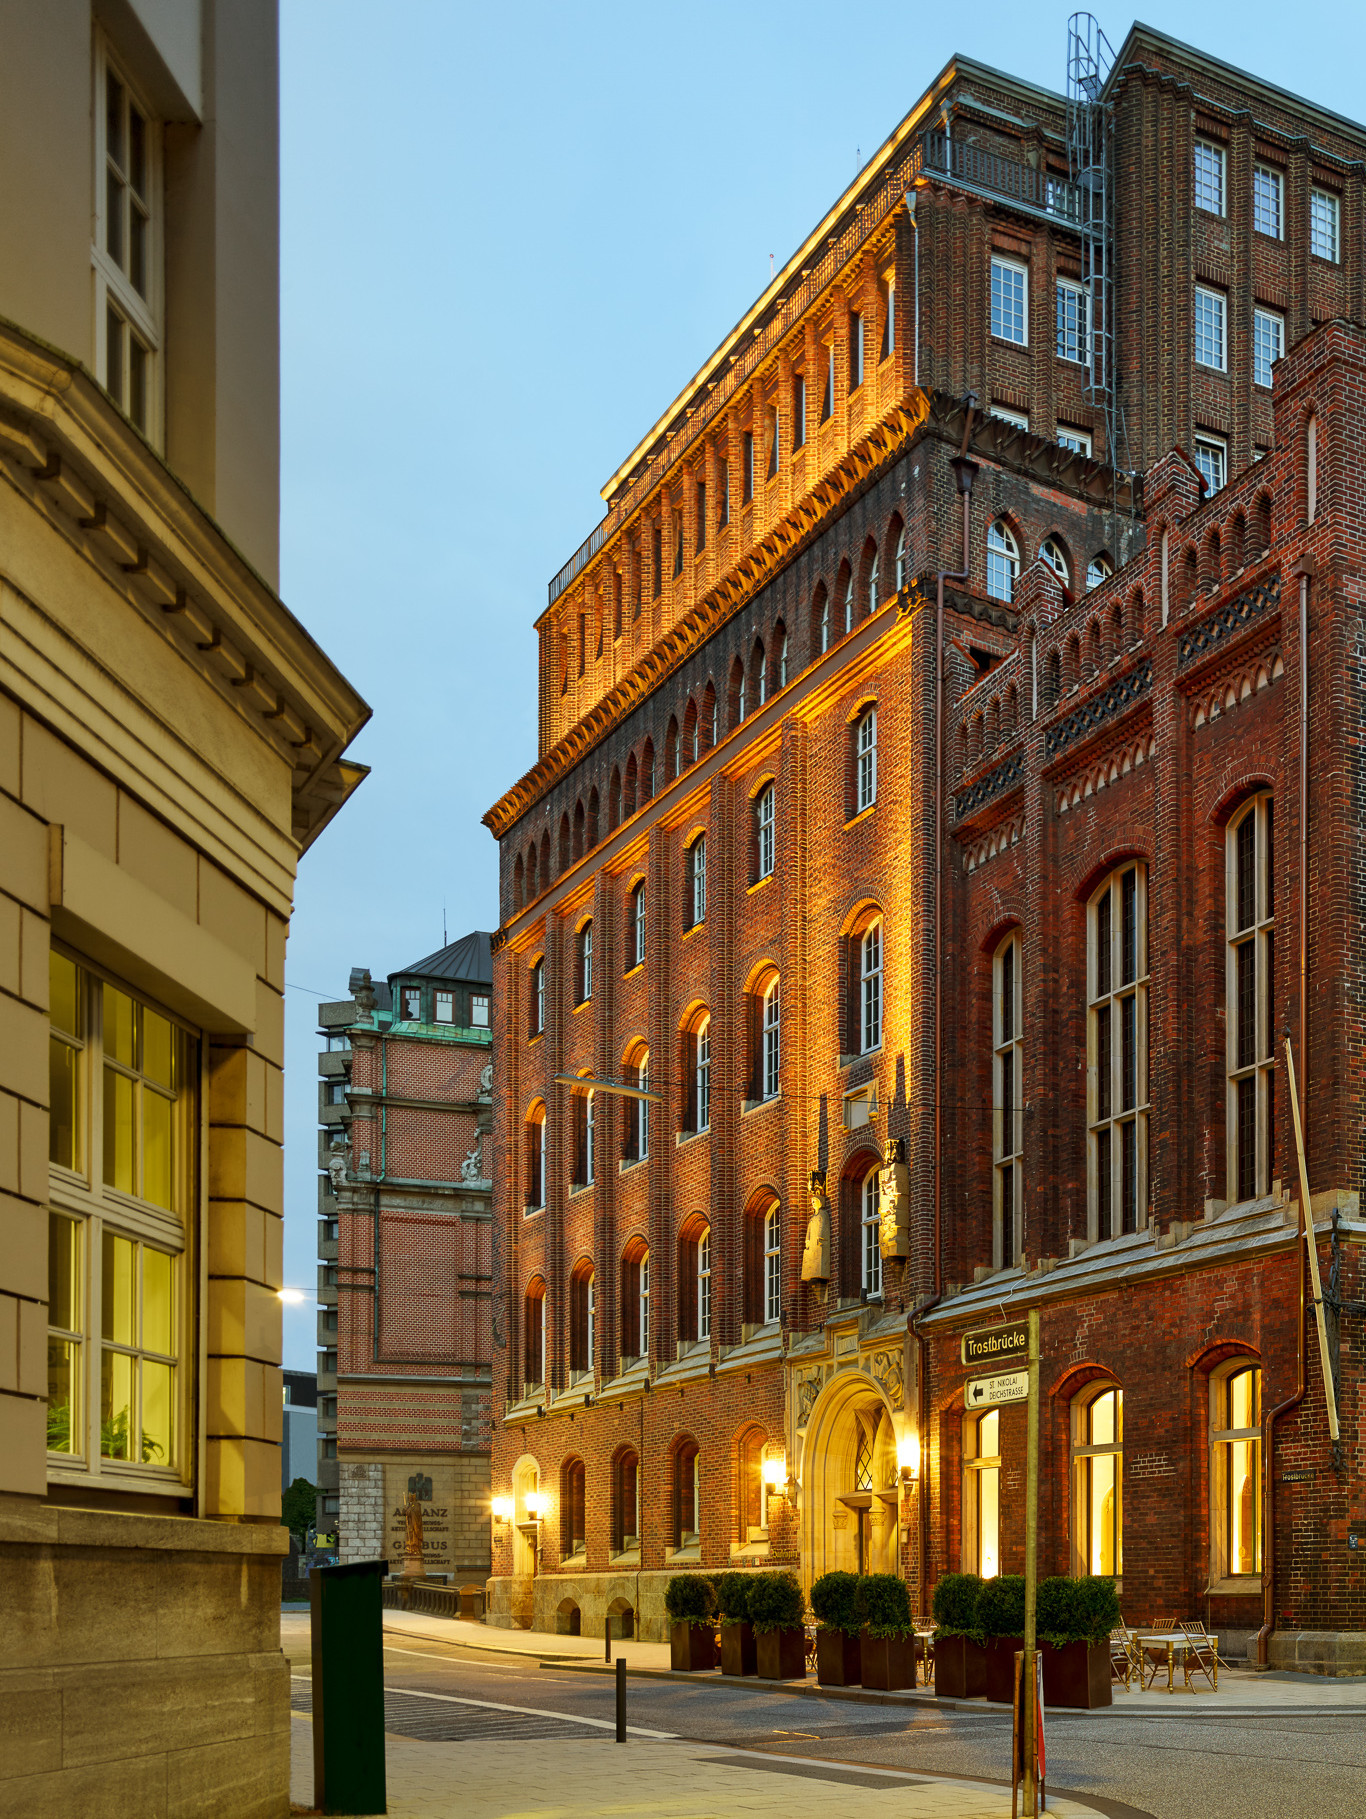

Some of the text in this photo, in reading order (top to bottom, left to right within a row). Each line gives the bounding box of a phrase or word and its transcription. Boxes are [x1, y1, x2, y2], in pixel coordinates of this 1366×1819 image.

[968, 1331, 1026, 1356] Trostbrücke
[997, 1376, 1018, 1388] NIKOLAI
[989, 1386, 1024, 1400] DEICHSTRASSE
